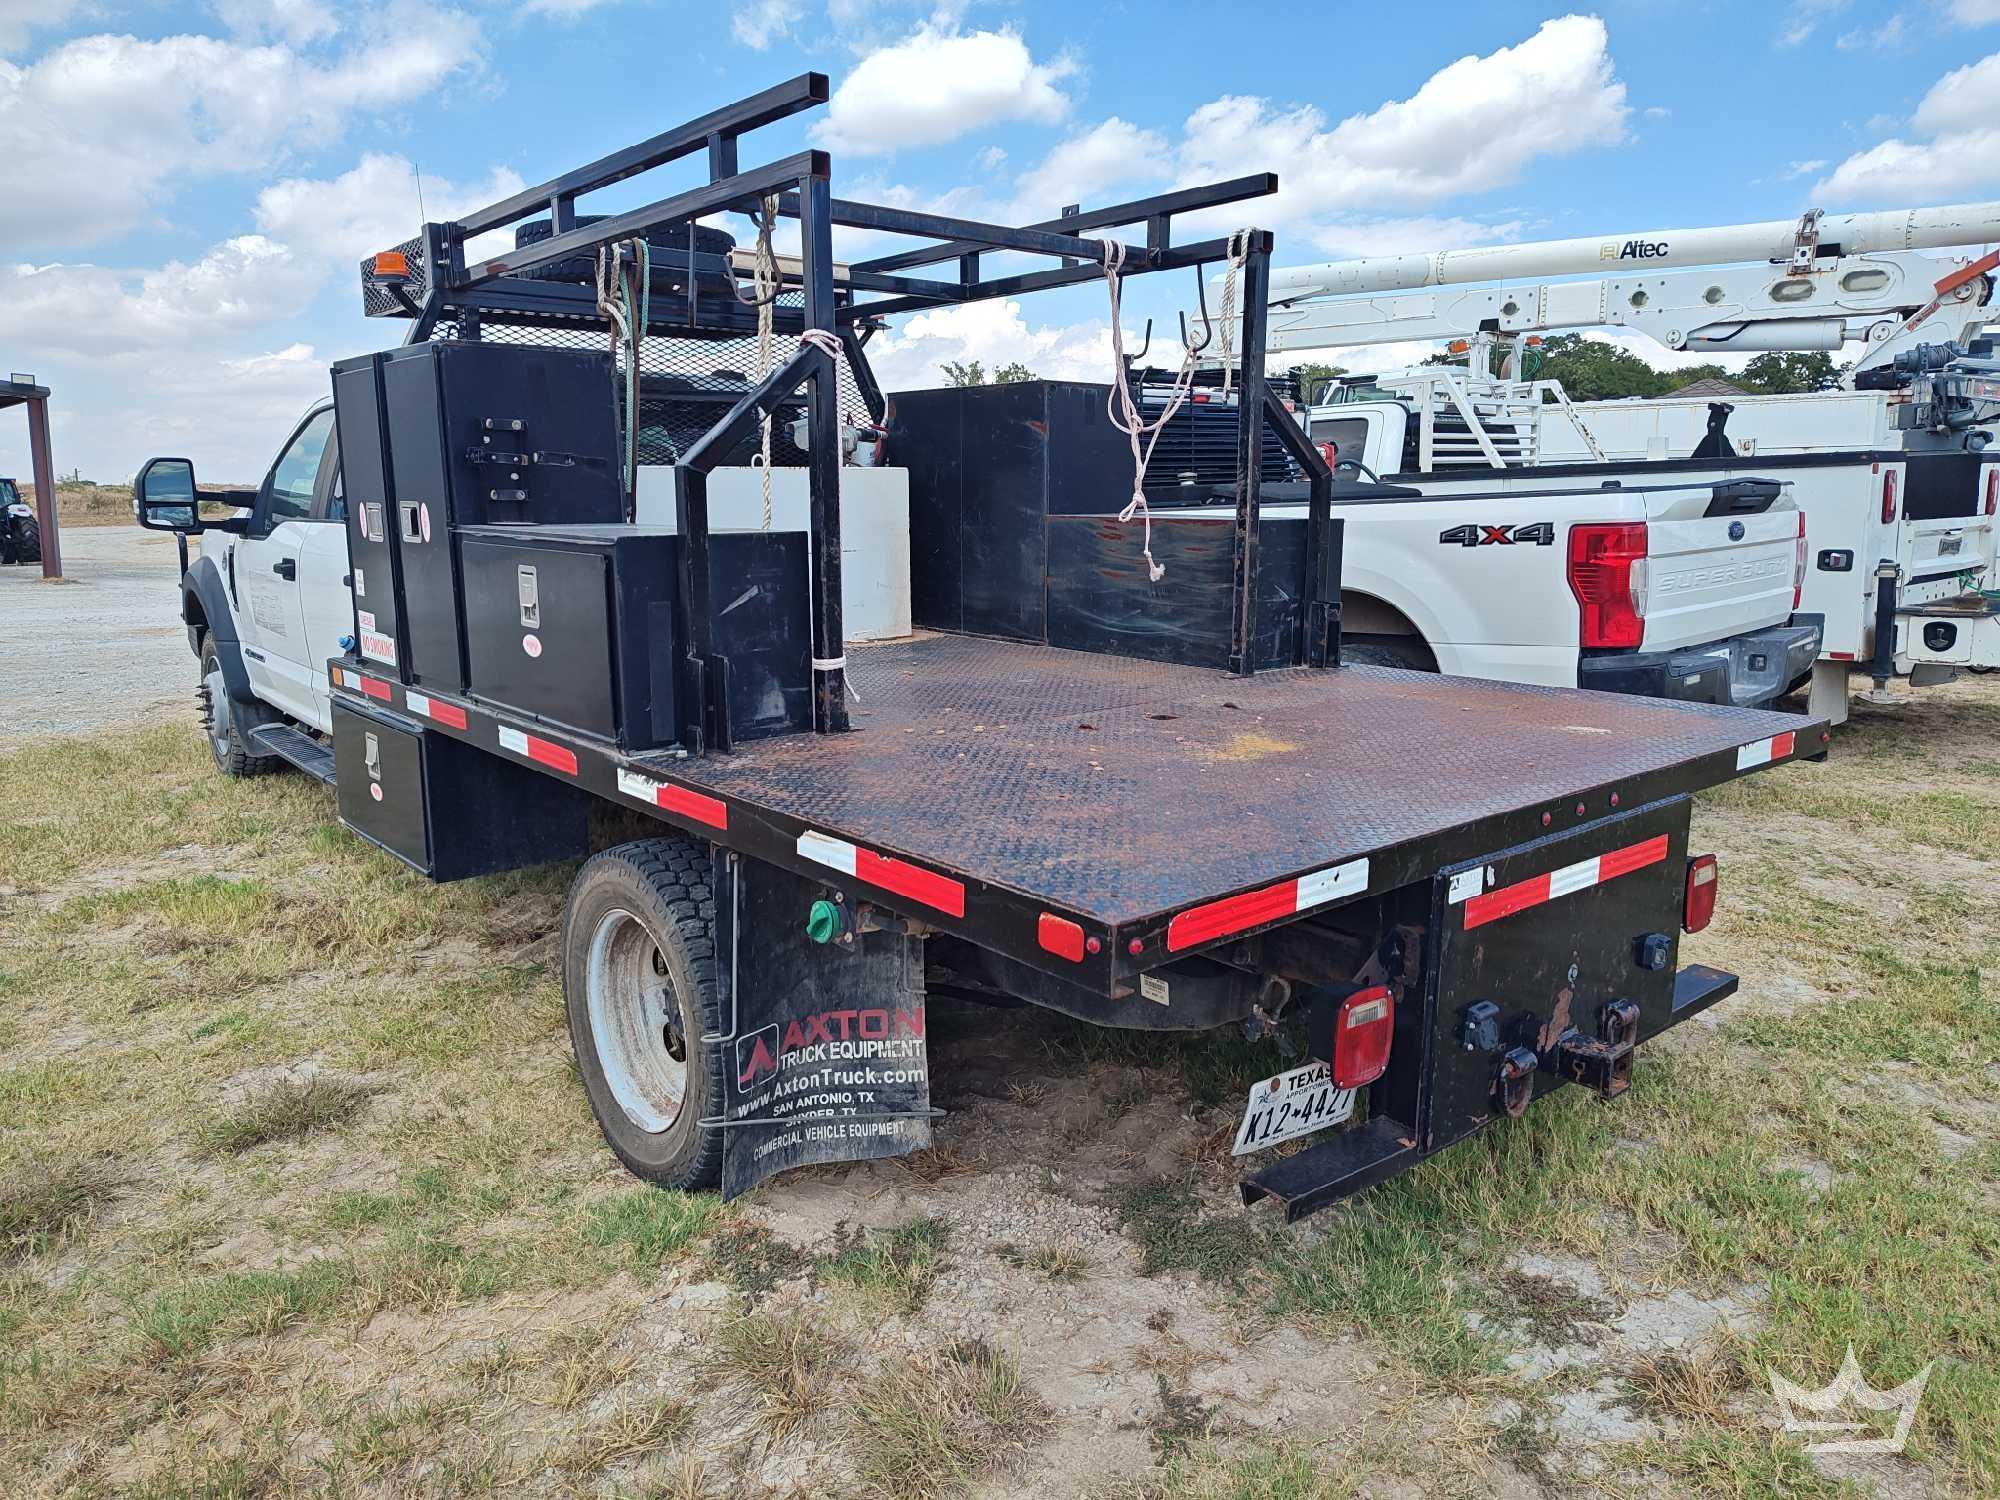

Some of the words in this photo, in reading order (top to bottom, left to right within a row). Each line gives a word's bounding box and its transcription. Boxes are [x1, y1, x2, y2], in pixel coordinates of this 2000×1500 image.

[1620, 239, 1669, 259] Altec
[1656, 565, 1737, 592] SUPER
[1742, 559, 1787, 579] DUTY
[370, 636, 393, 658] SMOKING
[782, 1008, 924, 1053] AXTON
[780, 1042, 827, 1071] TRUCK
[829, 1039, 923, 1060] EQUIPMENT
[737, 1066, 925, 1118] www.AxtonTruck.com
[772, 1101, 793, 1117] SAN
[796, 1092, 855, 1109] ANTONIO,
[858, 1091, 875, 1103] TX
[753, 1132, 802, 1162] COMMERCIAL
[805, 1124, 846, 1141] VEHICLE
[849, 1121, 905, 1138] EQUIPMENT
